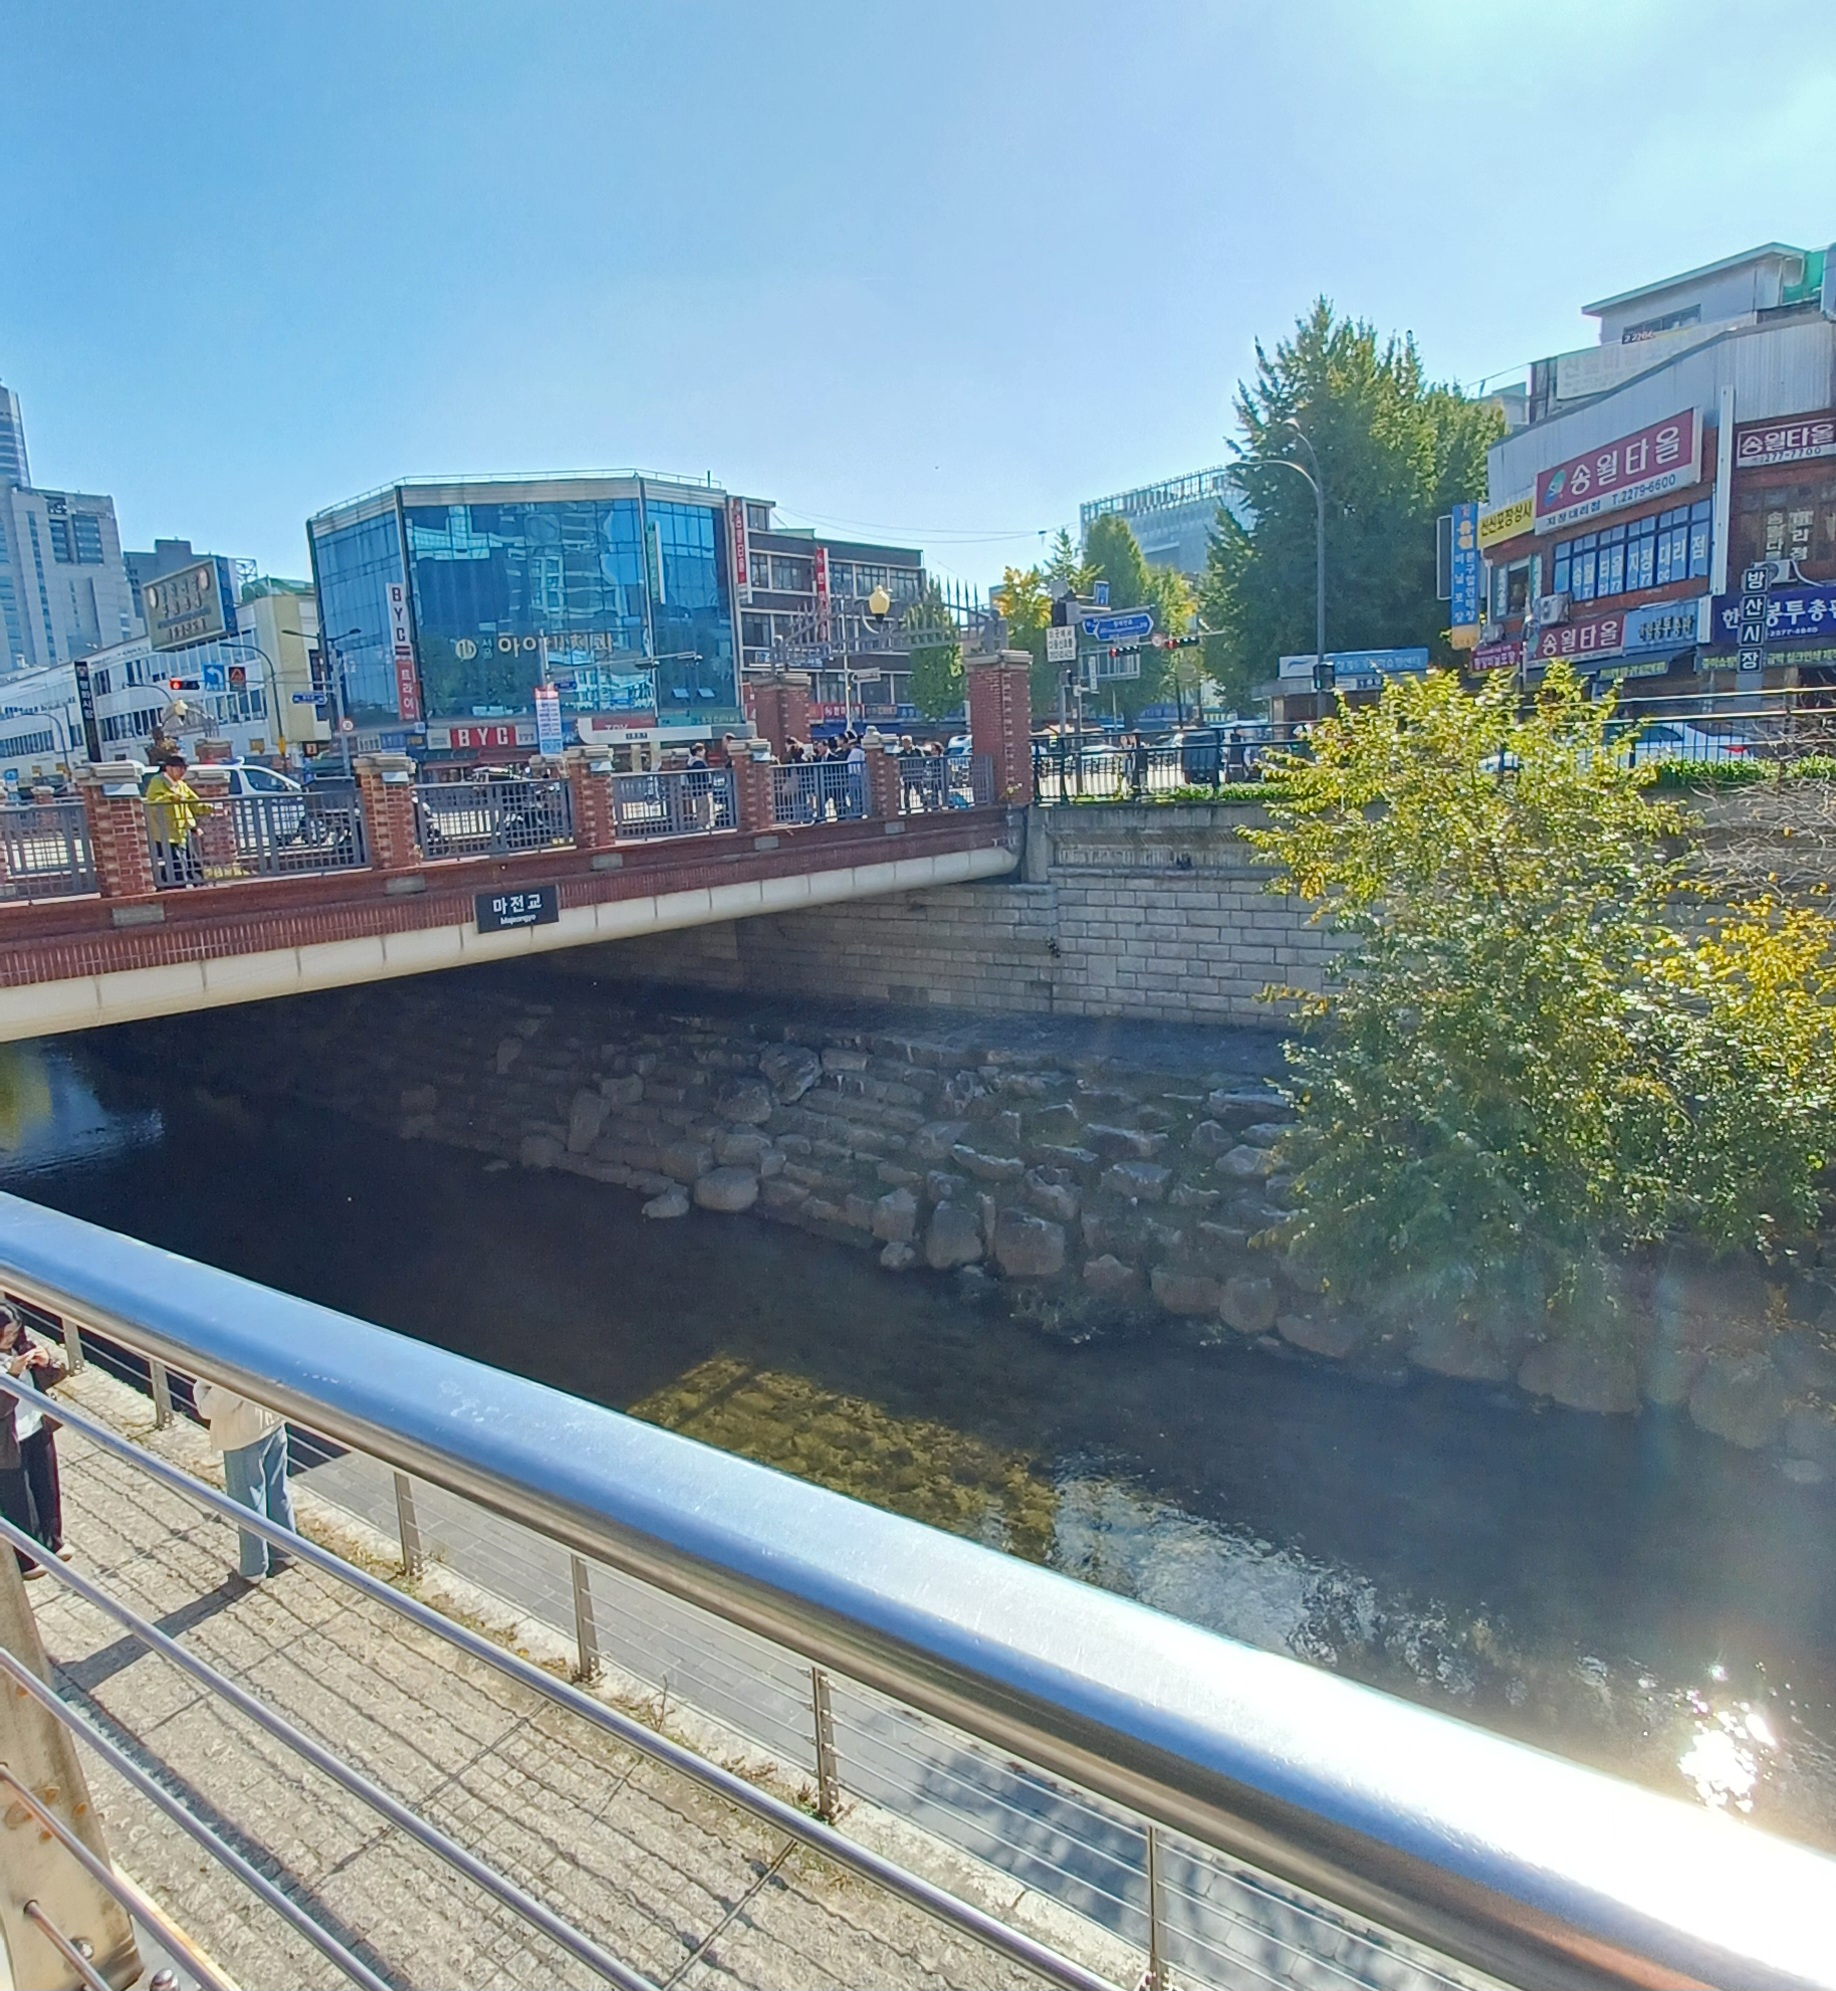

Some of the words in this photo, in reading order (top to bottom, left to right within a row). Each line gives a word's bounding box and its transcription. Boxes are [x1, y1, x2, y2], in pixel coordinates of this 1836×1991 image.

[1741, 424, 1834, 456] 송월타올
[1571, 426, 1680, 496] 송월타올
[1546, 500, 1600, 526] 지정대리점
[391, 587, 406, 642] BYC
[1741, 571, 1765, 670] 방산시장
[1542, 620, 1618, 656] 송월타올
[457, 727, 509, 747] BYC
[493, 893, 542, 915] 마전교
